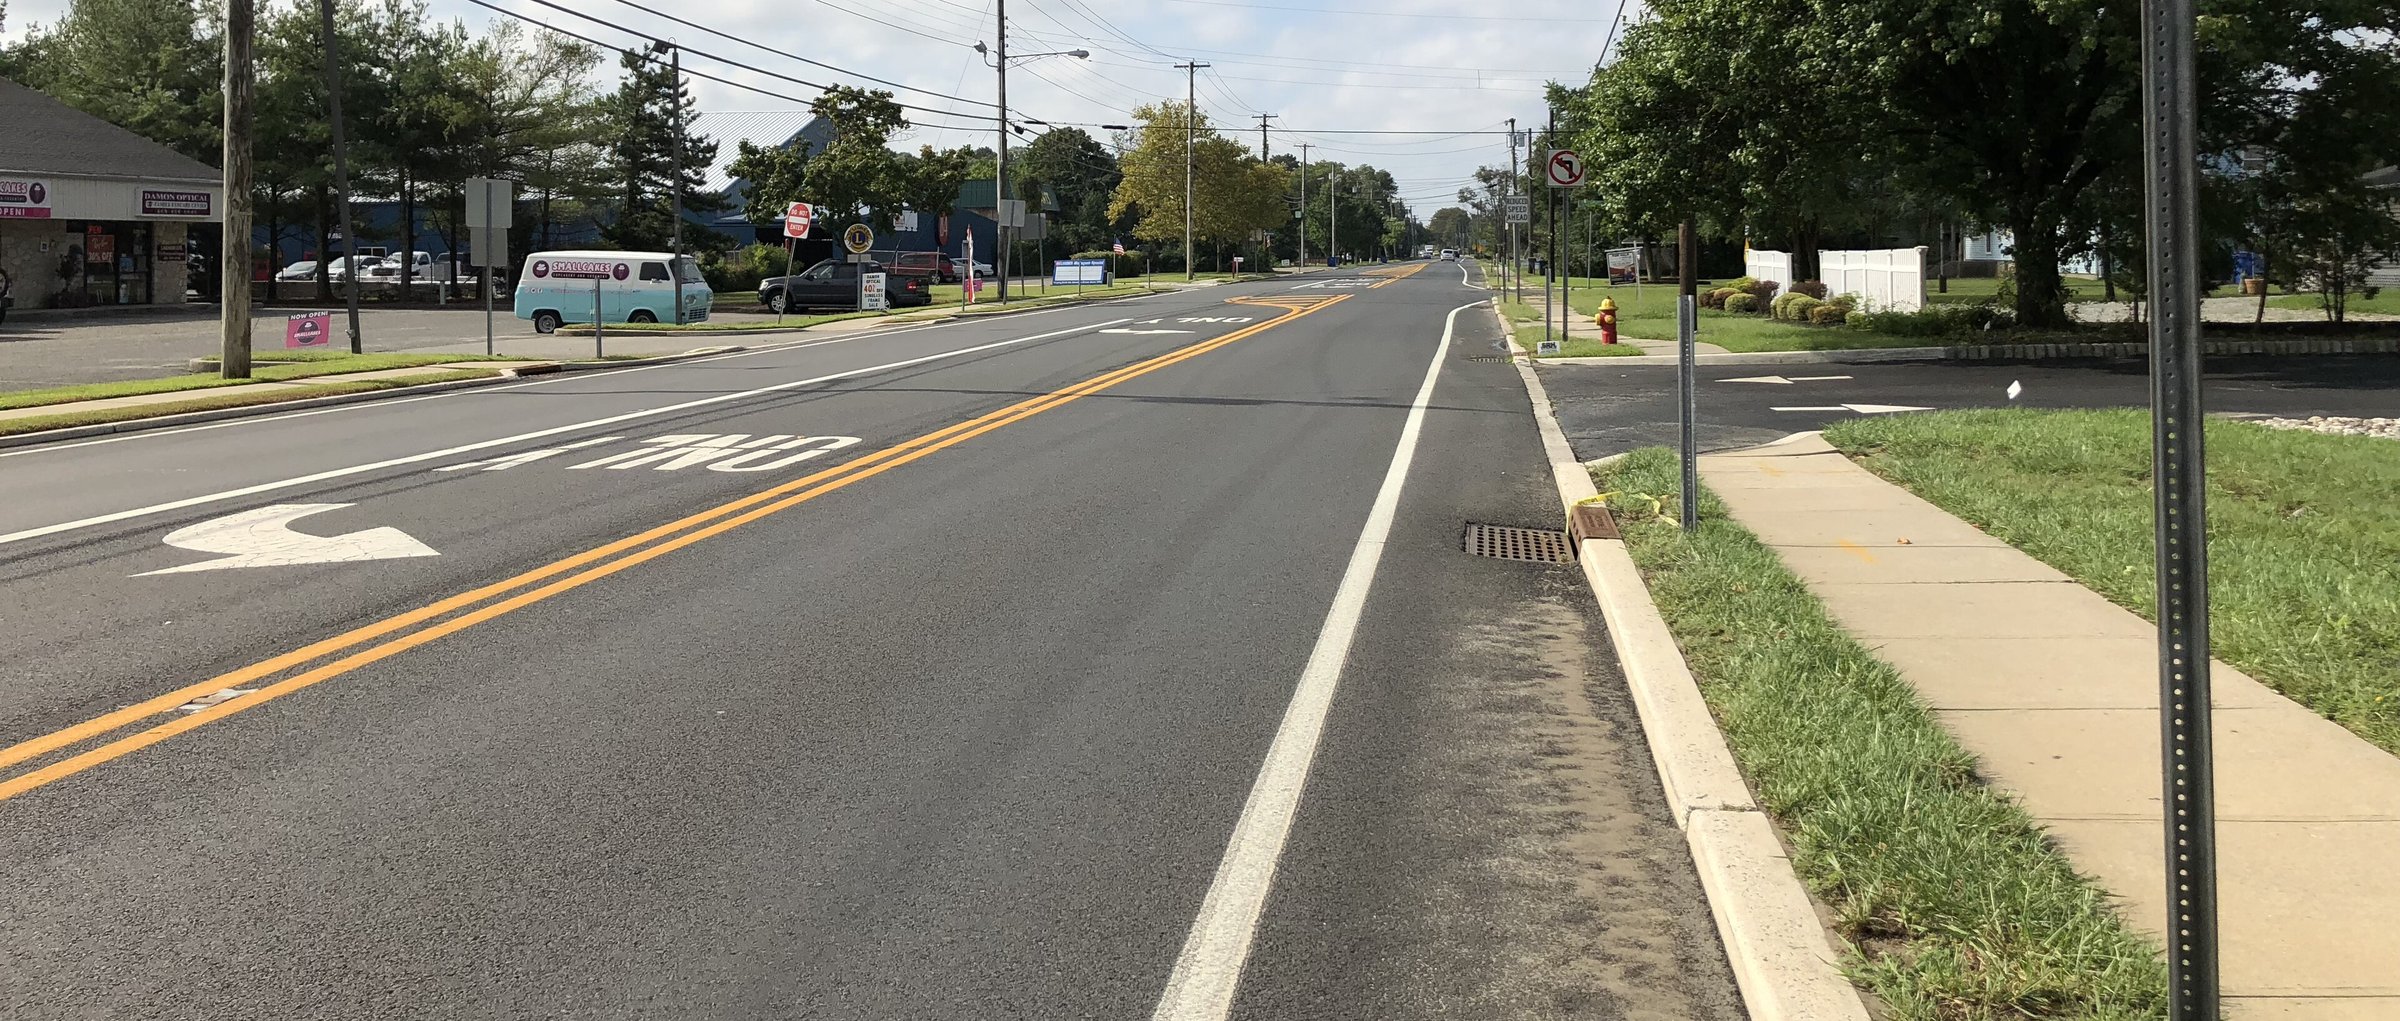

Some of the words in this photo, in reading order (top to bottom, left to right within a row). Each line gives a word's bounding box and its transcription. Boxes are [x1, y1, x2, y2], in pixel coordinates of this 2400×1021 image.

[855, 233, 862, 243] L
[101, 252, 113, 261] OFF
[552, 261, 611, 273] SMALLCAKES
